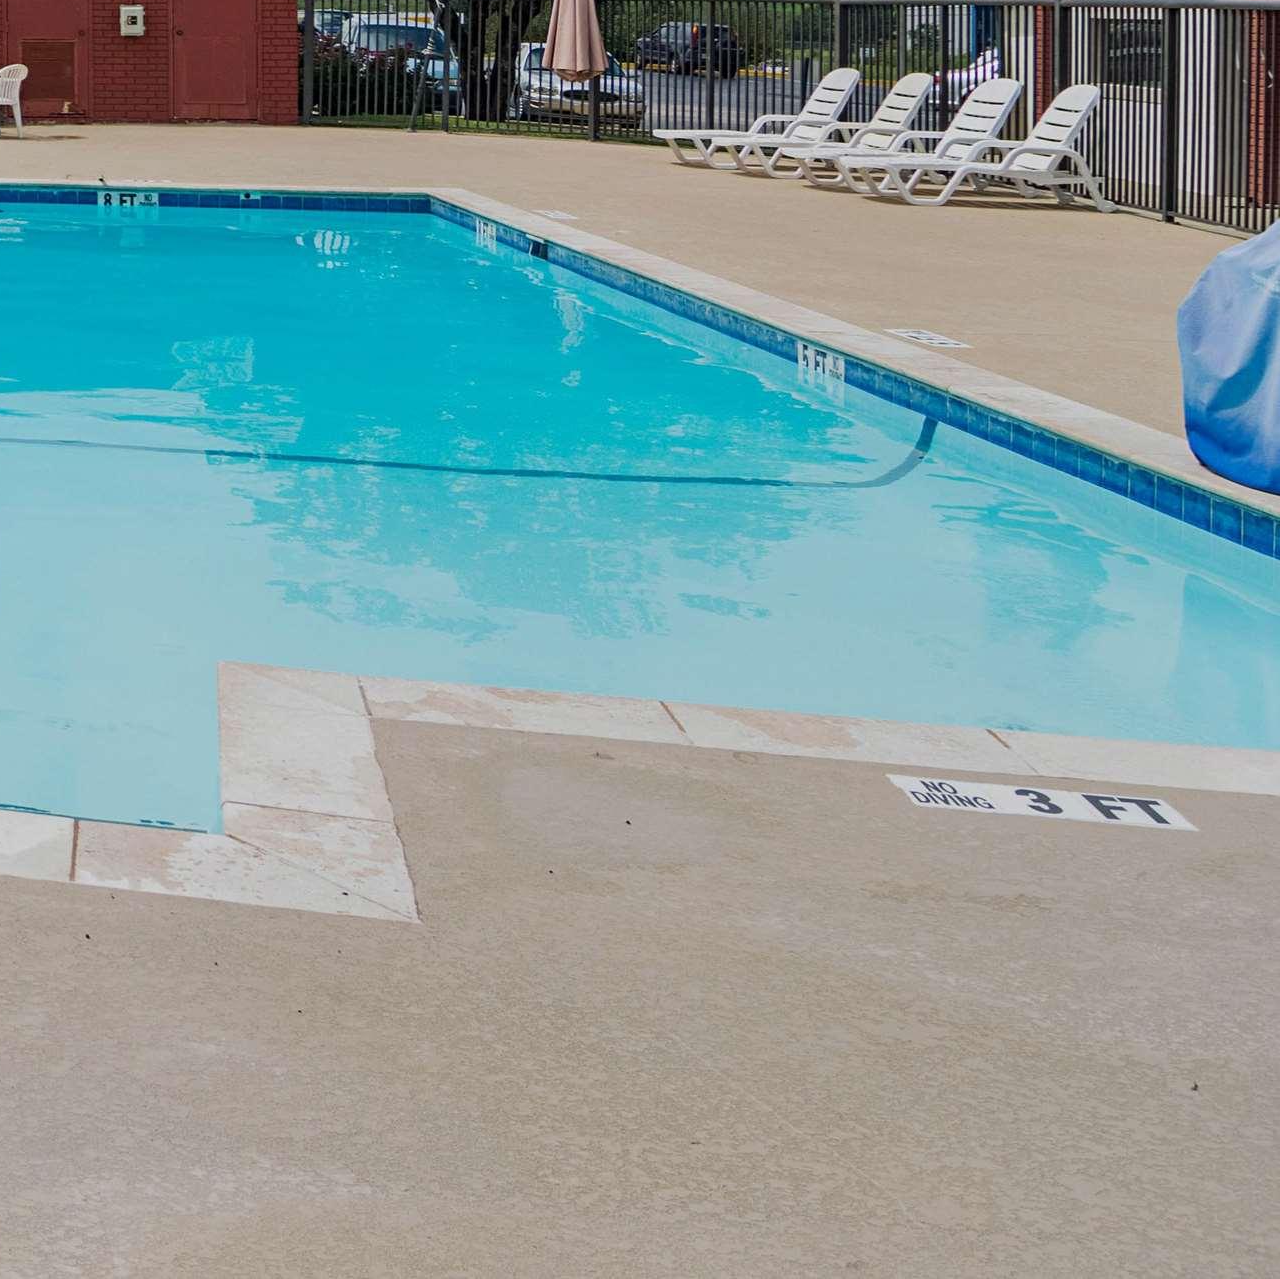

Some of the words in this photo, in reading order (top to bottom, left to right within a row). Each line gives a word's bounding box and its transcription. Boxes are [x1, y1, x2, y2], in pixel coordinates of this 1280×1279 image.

[104, 193, 112, 206] 8
[120, 194, 137, 206] FT
[814, 350, 827, 374] FT
[920, 780, 958, 794] NO
[909, 791, 995, 809] DIVING
[1015, 788, 1064, 815] 3
[1082, 794, 1171, 825] FT
